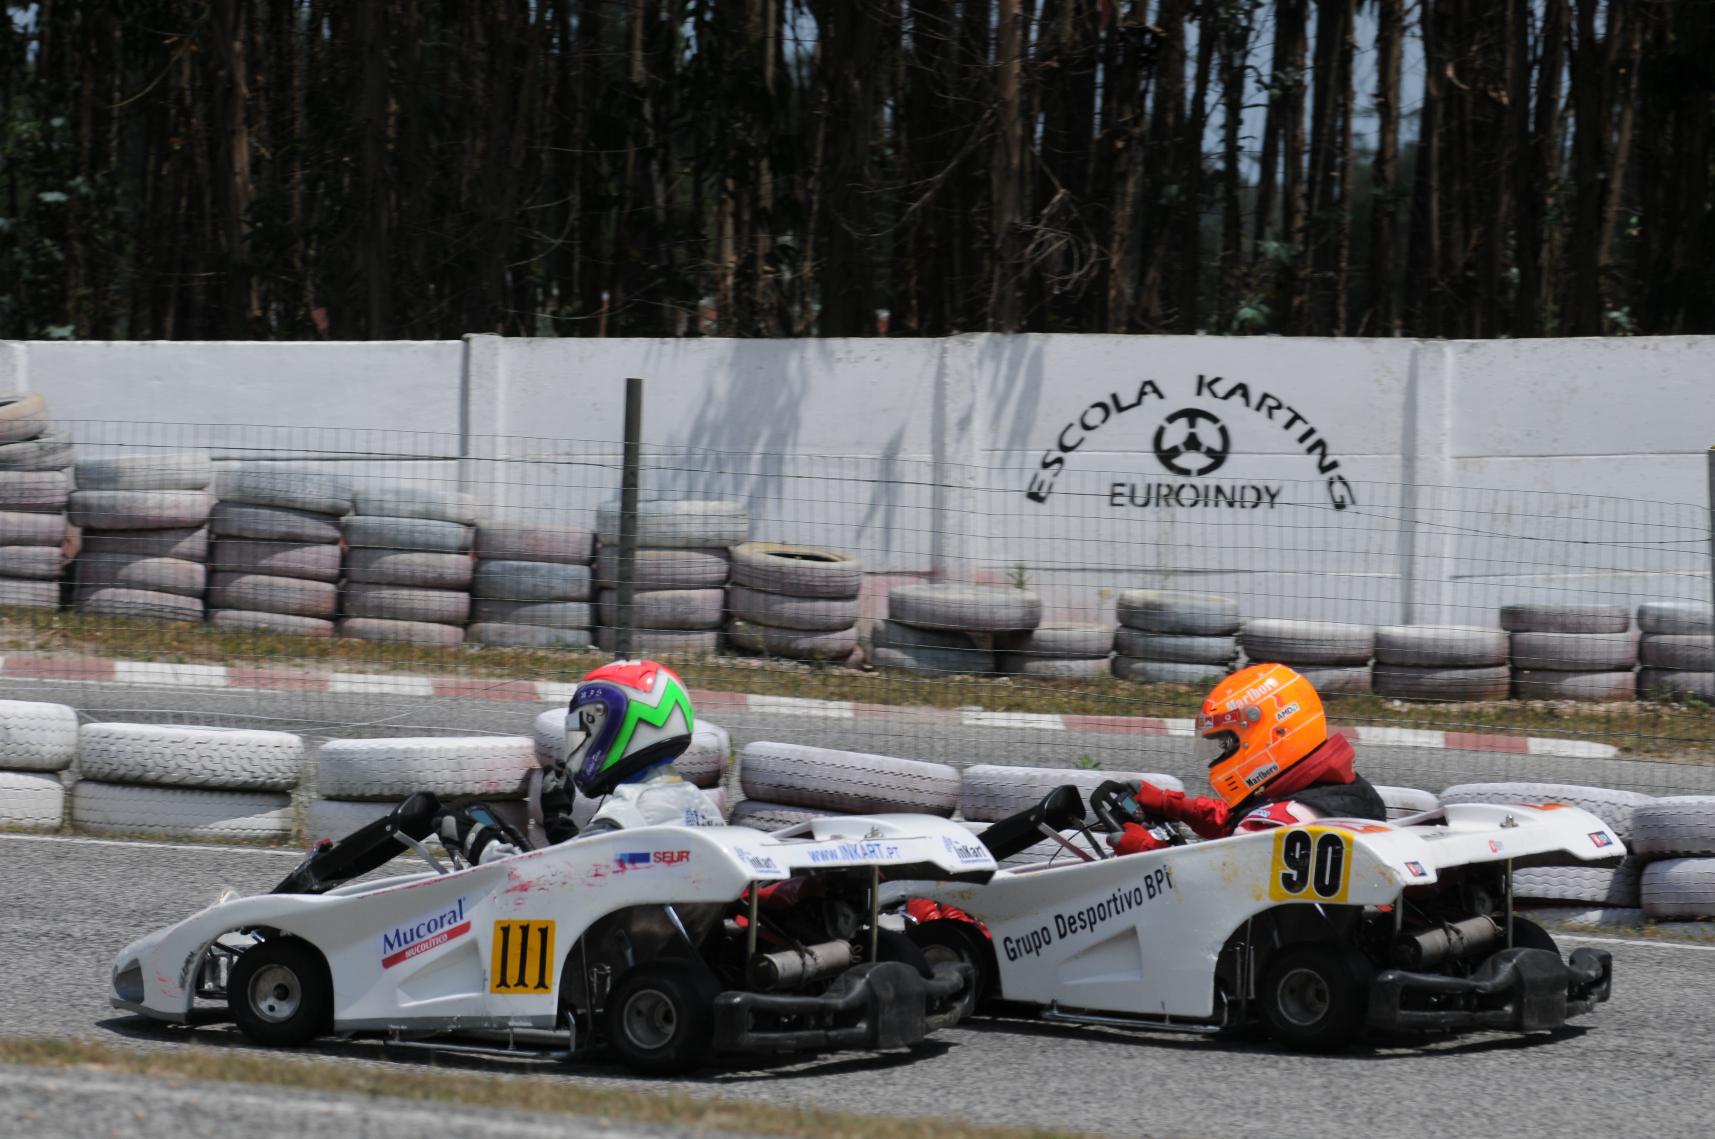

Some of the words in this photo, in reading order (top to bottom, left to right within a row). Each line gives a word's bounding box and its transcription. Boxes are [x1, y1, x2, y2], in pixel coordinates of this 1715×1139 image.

[1026, 379, 1166, 504] ESCOLA
[1196, 374, 1357, 511] KARTING
[1109, 481, 1282, 508] EUROINDY
[1244, 762, 1280, 788] Marlboro
[653, 850, 691, 864] SEUR
[1280, 829, 1346, 898] 90
[383, 898, 464, 954] Mucoral
[1003, 925, 1053, 962] Grupo
[1053, 885, 1144, 940] Desportivo
[495, 923, 550, 990] 111
